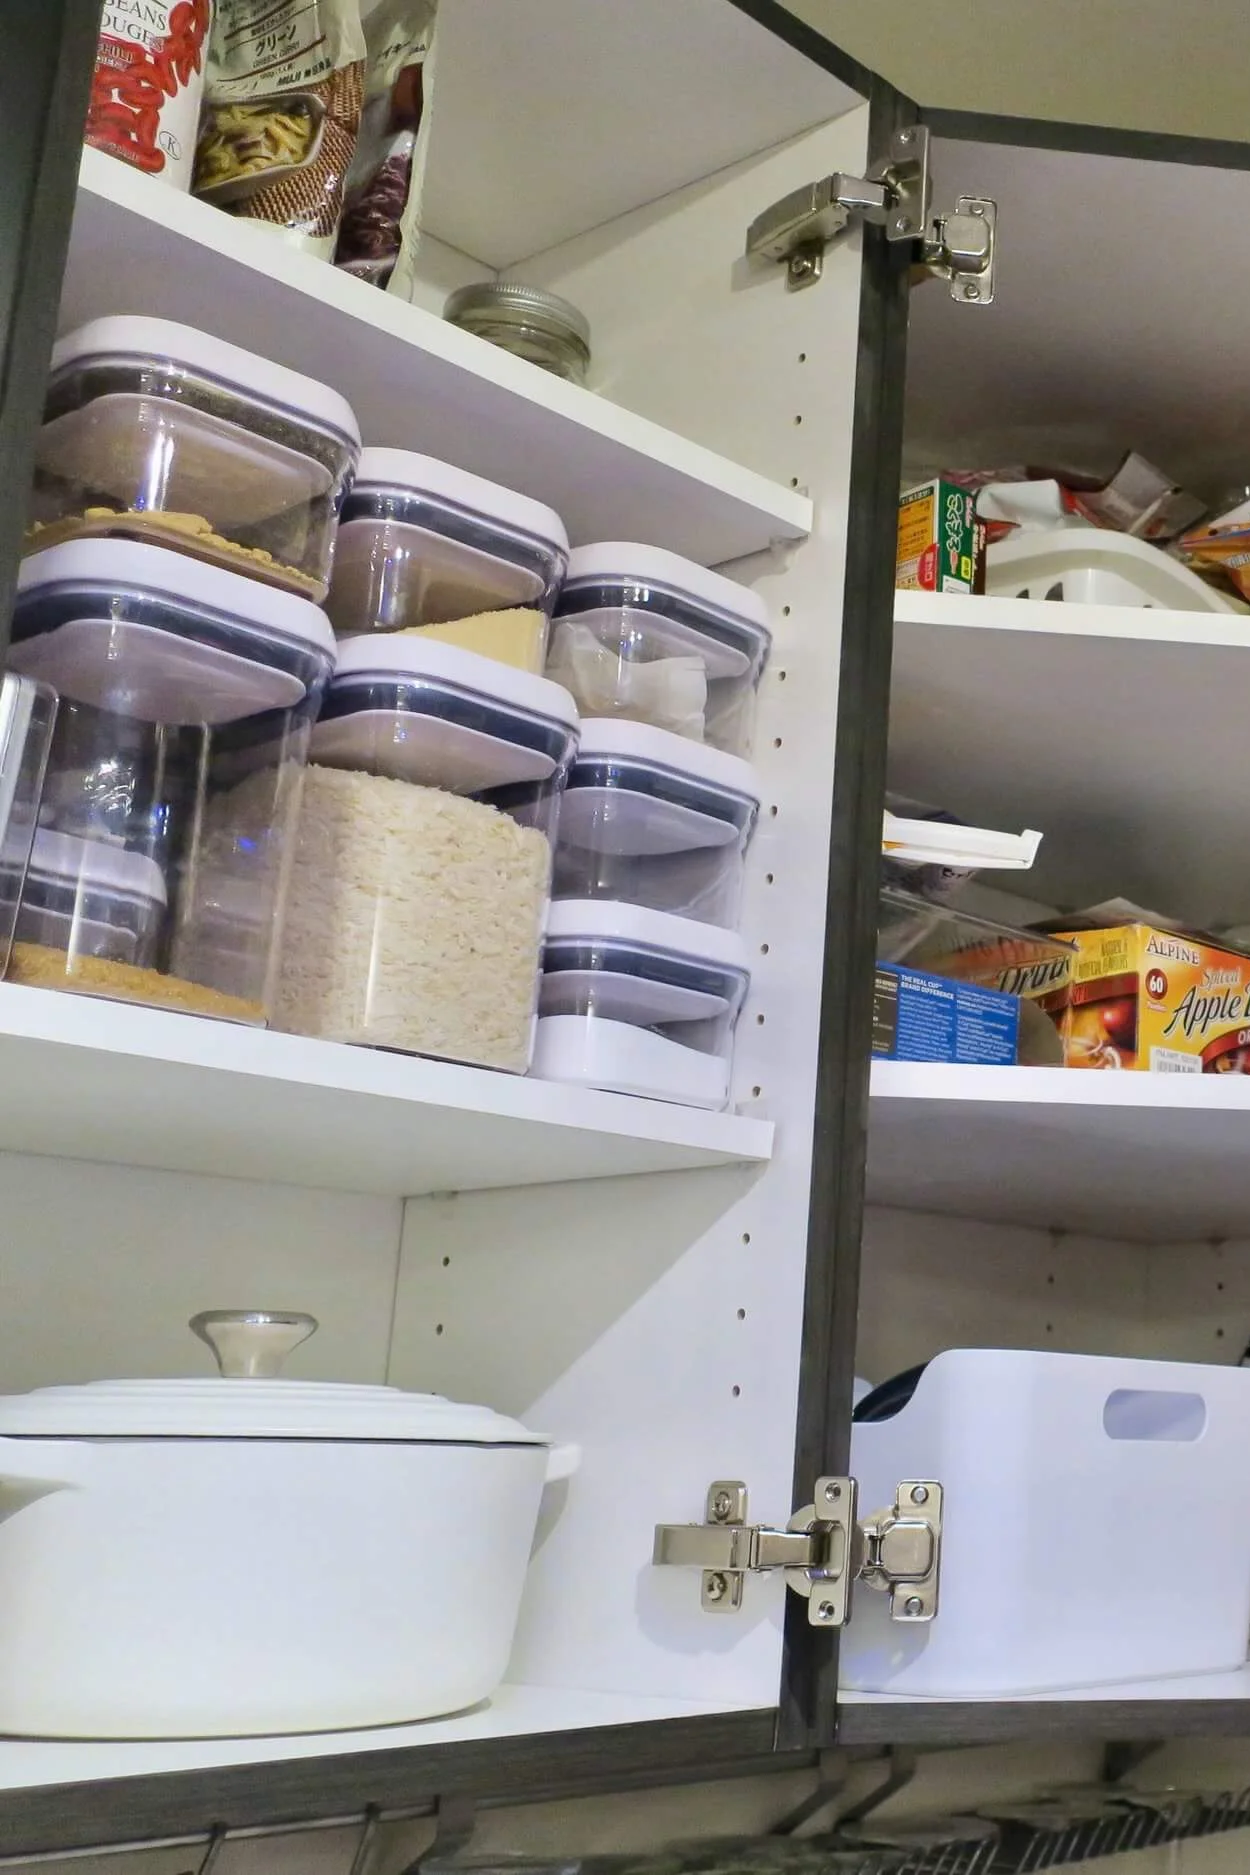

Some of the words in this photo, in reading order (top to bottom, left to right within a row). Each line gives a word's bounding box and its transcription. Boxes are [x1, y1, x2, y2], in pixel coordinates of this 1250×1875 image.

[1146, 935, 1200, 965] ALPINE
[1149, 976, 1164, 993] 60
[1163, 986, 1242, 1037] Apple
